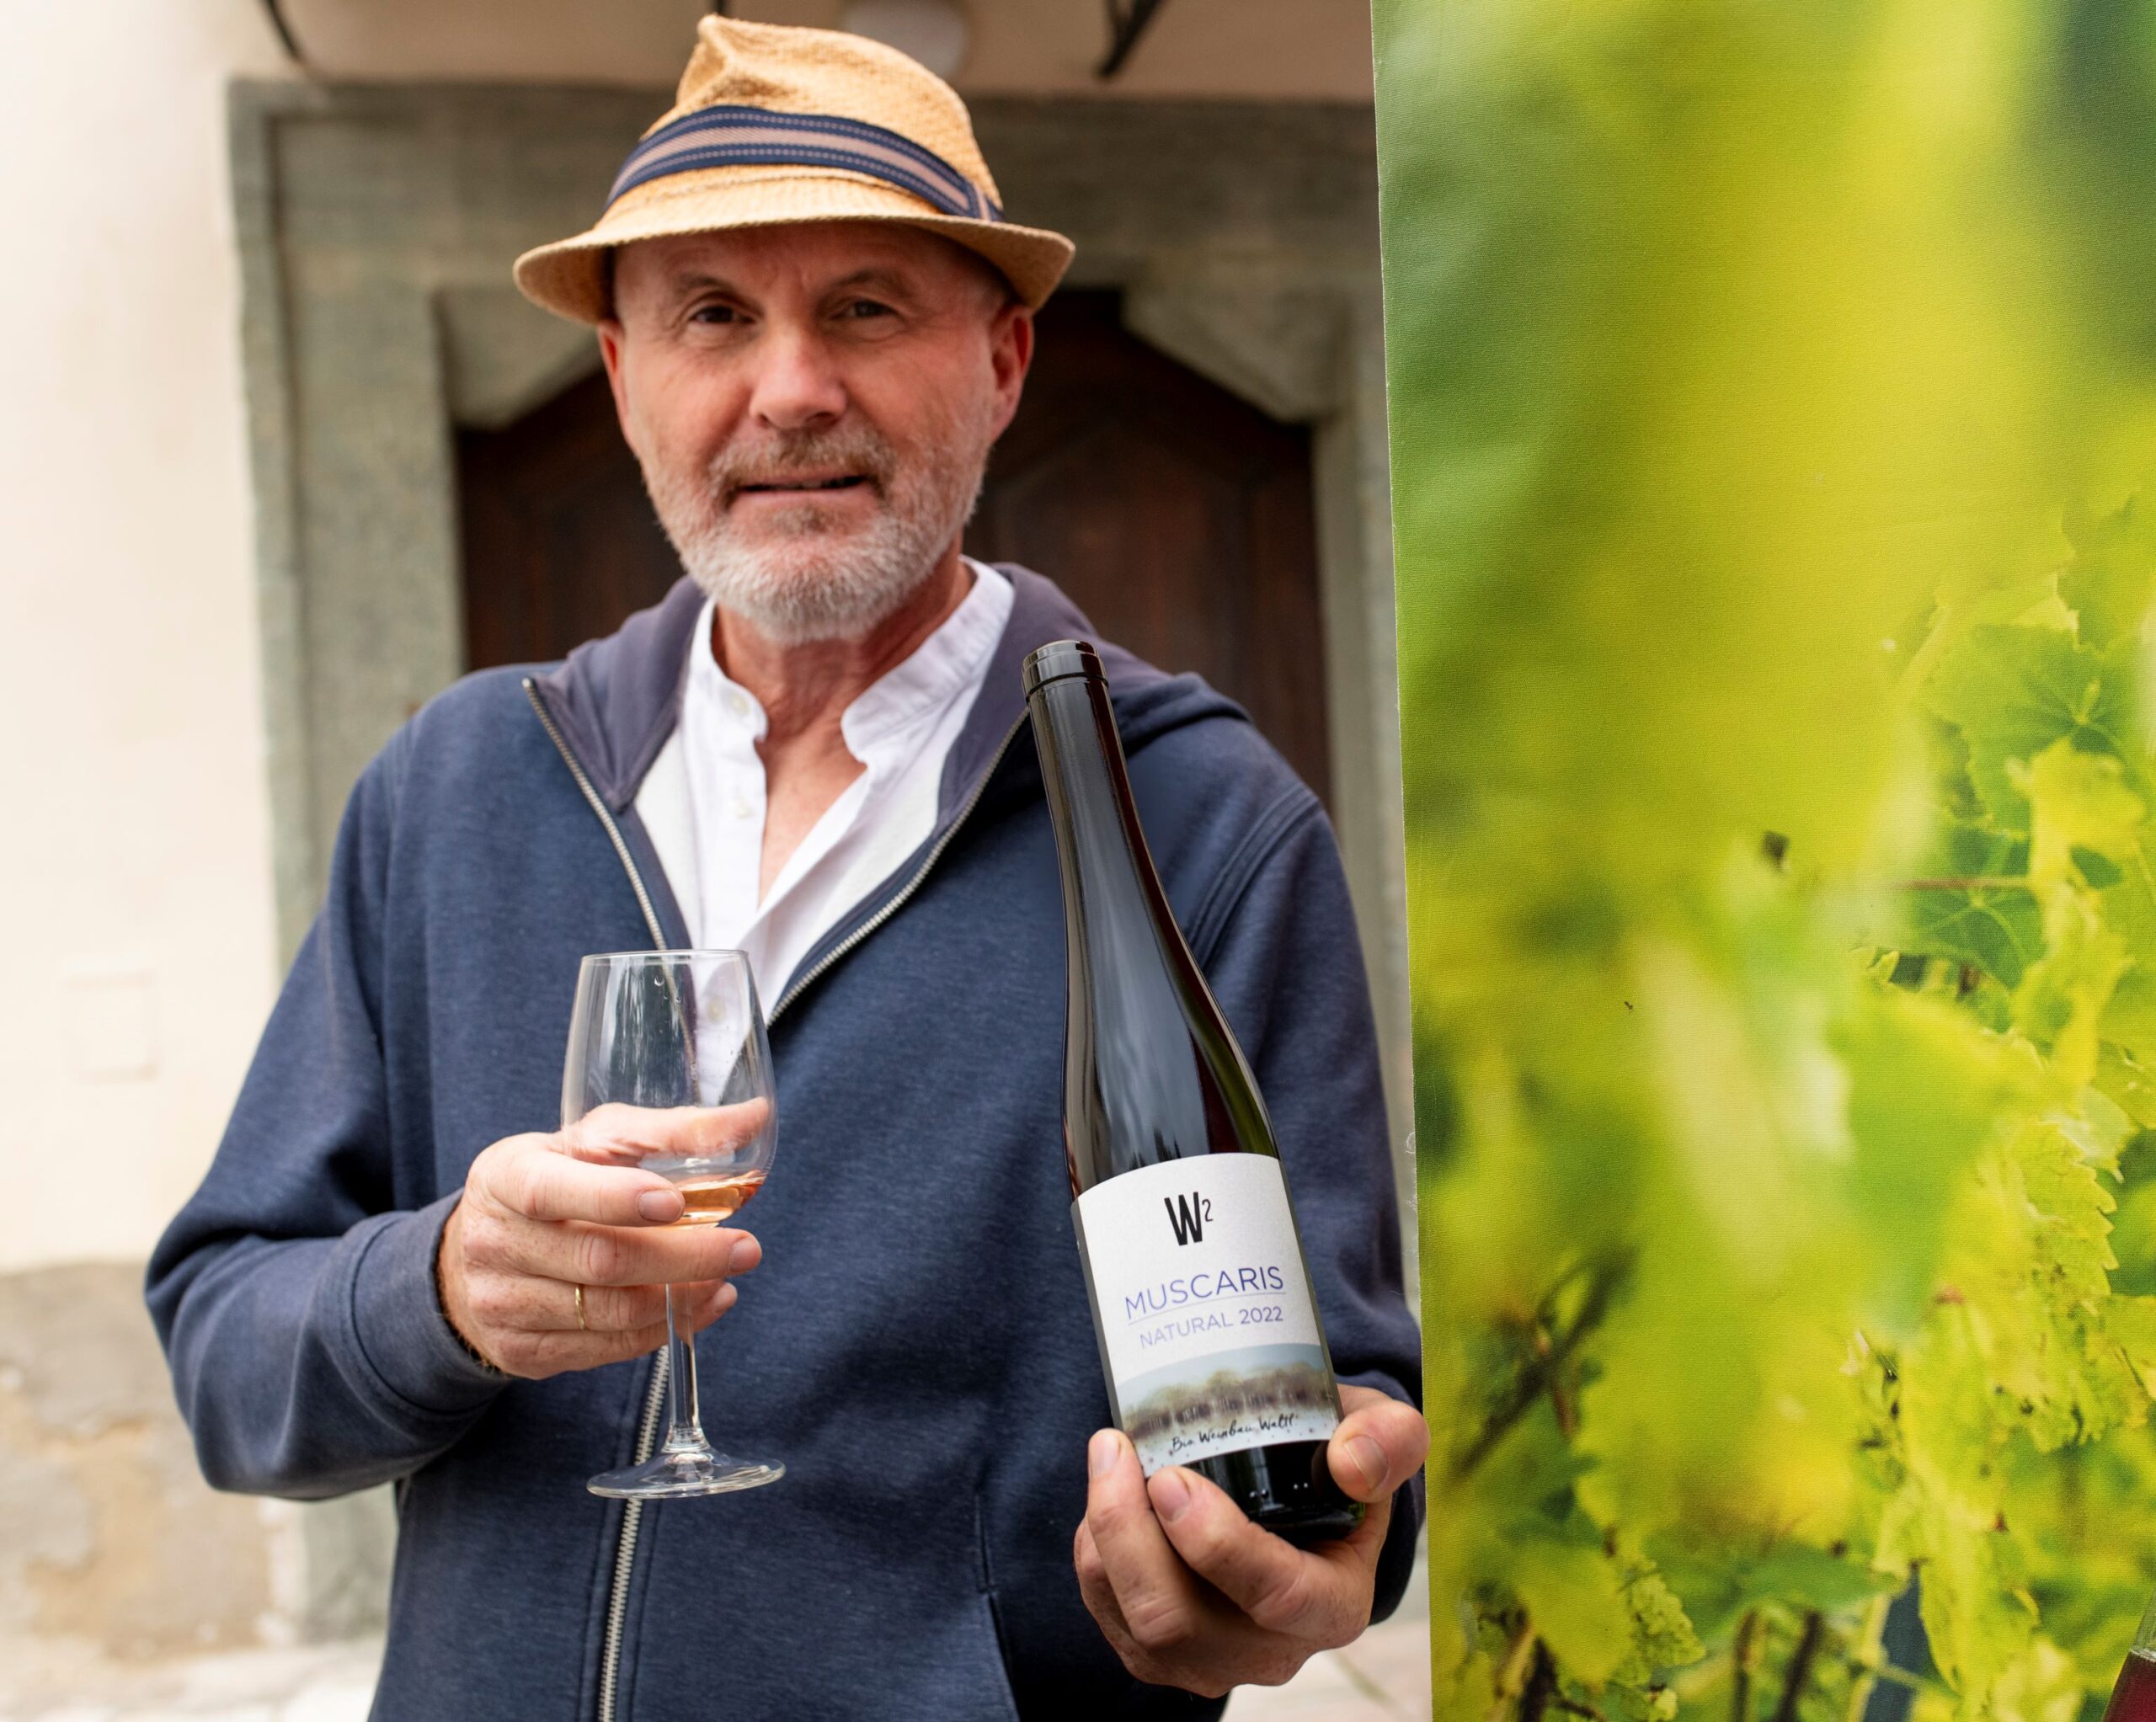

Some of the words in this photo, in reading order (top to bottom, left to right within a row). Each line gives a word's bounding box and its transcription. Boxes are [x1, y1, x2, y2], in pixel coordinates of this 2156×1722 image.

[1125, 1266, 1284, 1319] MUSCARIS
[1139, 1312, 1234, 1349] NATURAL
[1239, 1305, 1284, 1325] 2022
[1171, 1437, 1194, 1453] Bio
[1198, 1420, 1253, 1443] Weinbau
